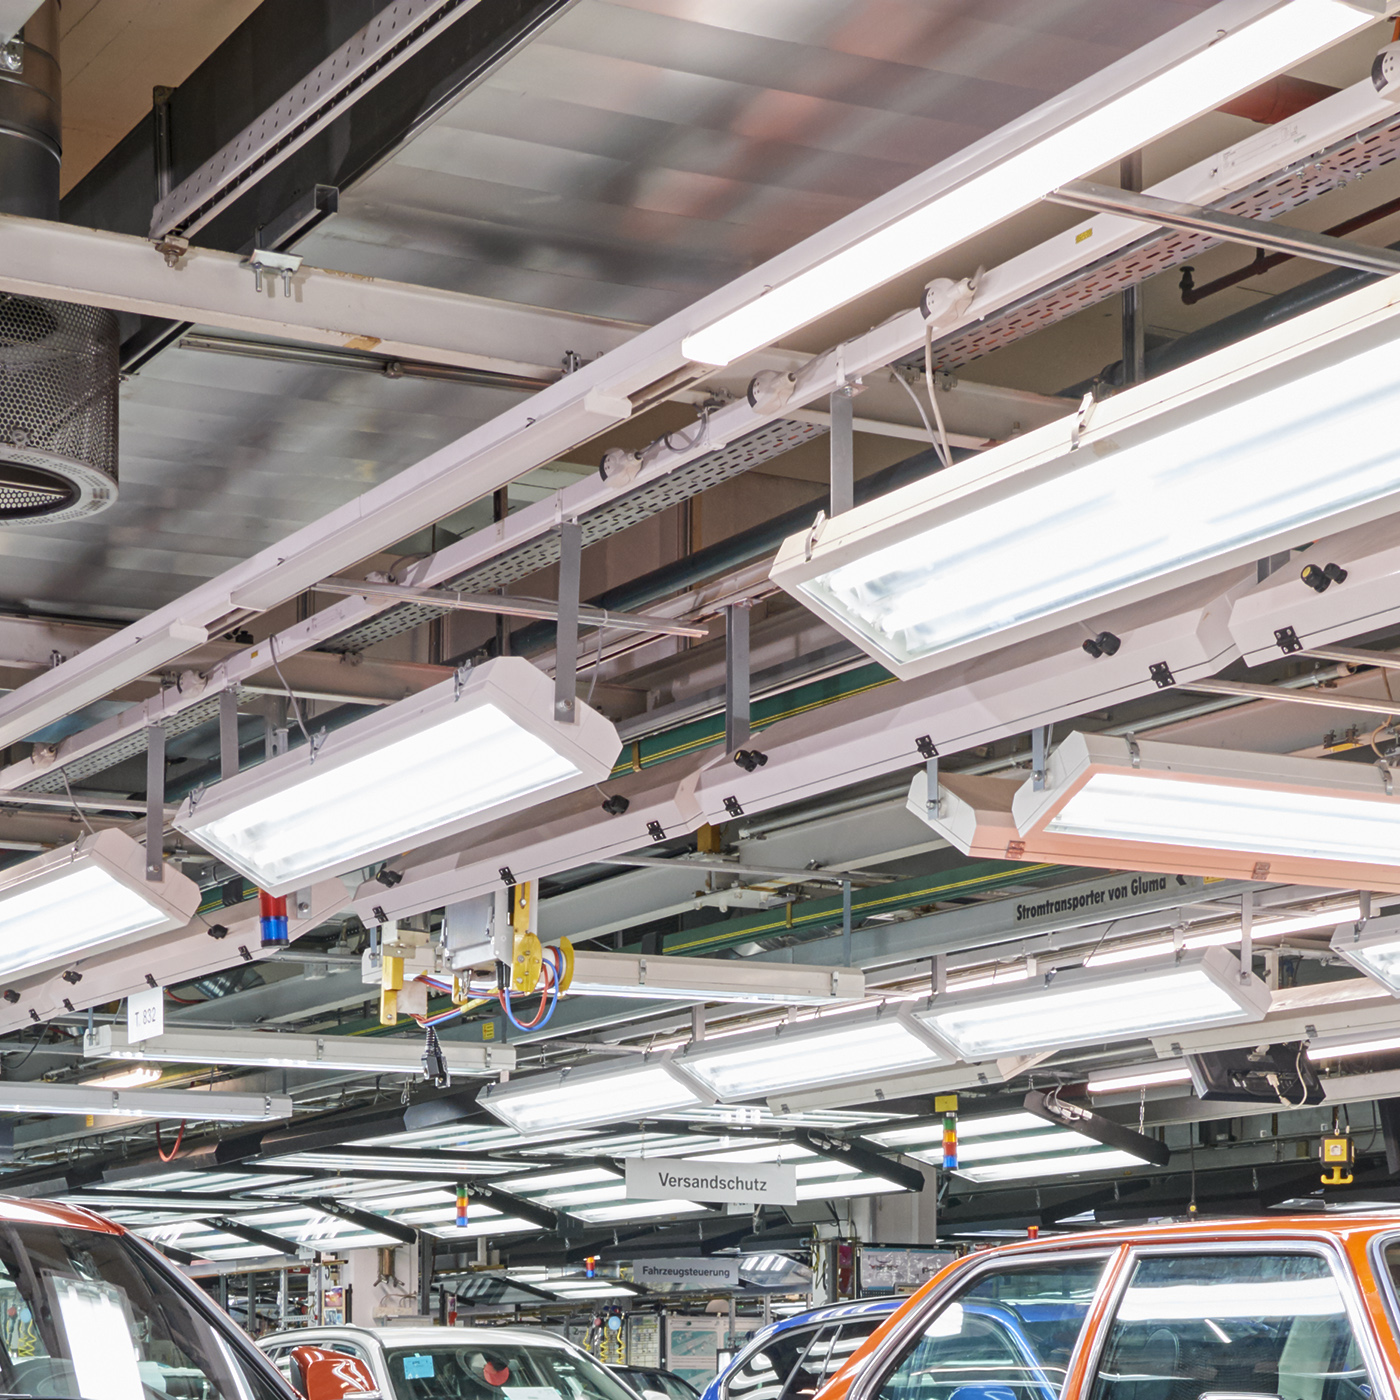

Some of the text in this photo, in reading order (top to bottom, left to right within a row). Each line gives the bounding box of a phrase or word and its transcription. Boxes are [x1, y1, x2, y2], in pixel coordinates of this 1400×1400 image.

[1016, 875, 1167, 921] Stromtransporter von Gluma
[659, 1172, 767, 1191] Versandschutz
[642, 1265, 730, 1278] Fahrzeugsteuerung
